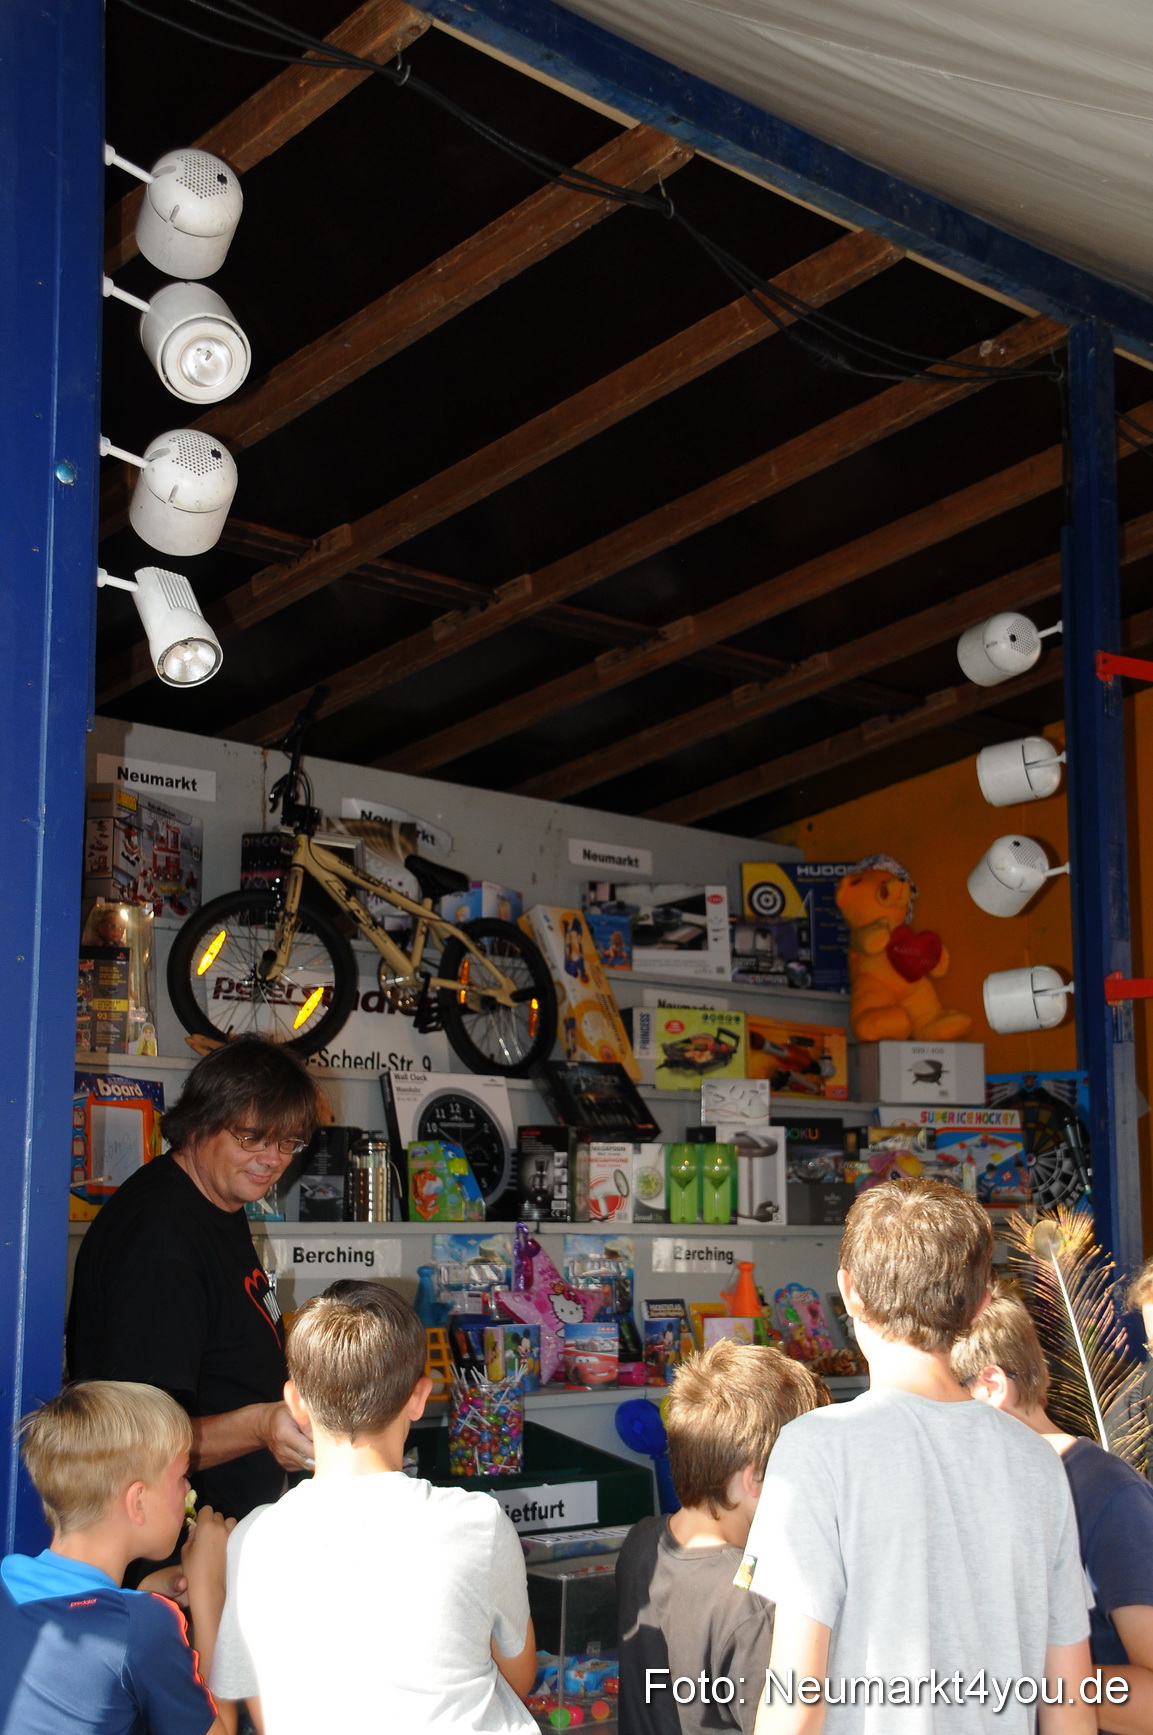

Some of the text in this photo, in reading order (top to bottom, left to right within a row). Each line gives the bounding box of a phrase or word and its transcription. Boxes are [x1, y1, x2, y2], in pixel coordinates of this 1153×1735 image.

[117, 766, 198, 792] Neumarkt
[583, 849, 639, 868] Neumarkt
[640, 1013, 649, 1049] PRINCESS
[422, 1056, 432, 1072] 9
[97, 1078, 143, 1096] board
[436, 1108, 446, 1119] 11
[450, 1103, 460, 1113] 12
[469, 1108, 475, 1119] 1
[920, 1111, 1015, 1124] SUPER ICE HOCKEY
[426, 1122, 438, 1133] 10
[293, 1247, 375, 1267] Berching
[674, 1246, 734, 1265] Berching
[505, 1500, 565, 1523] ietfurt
